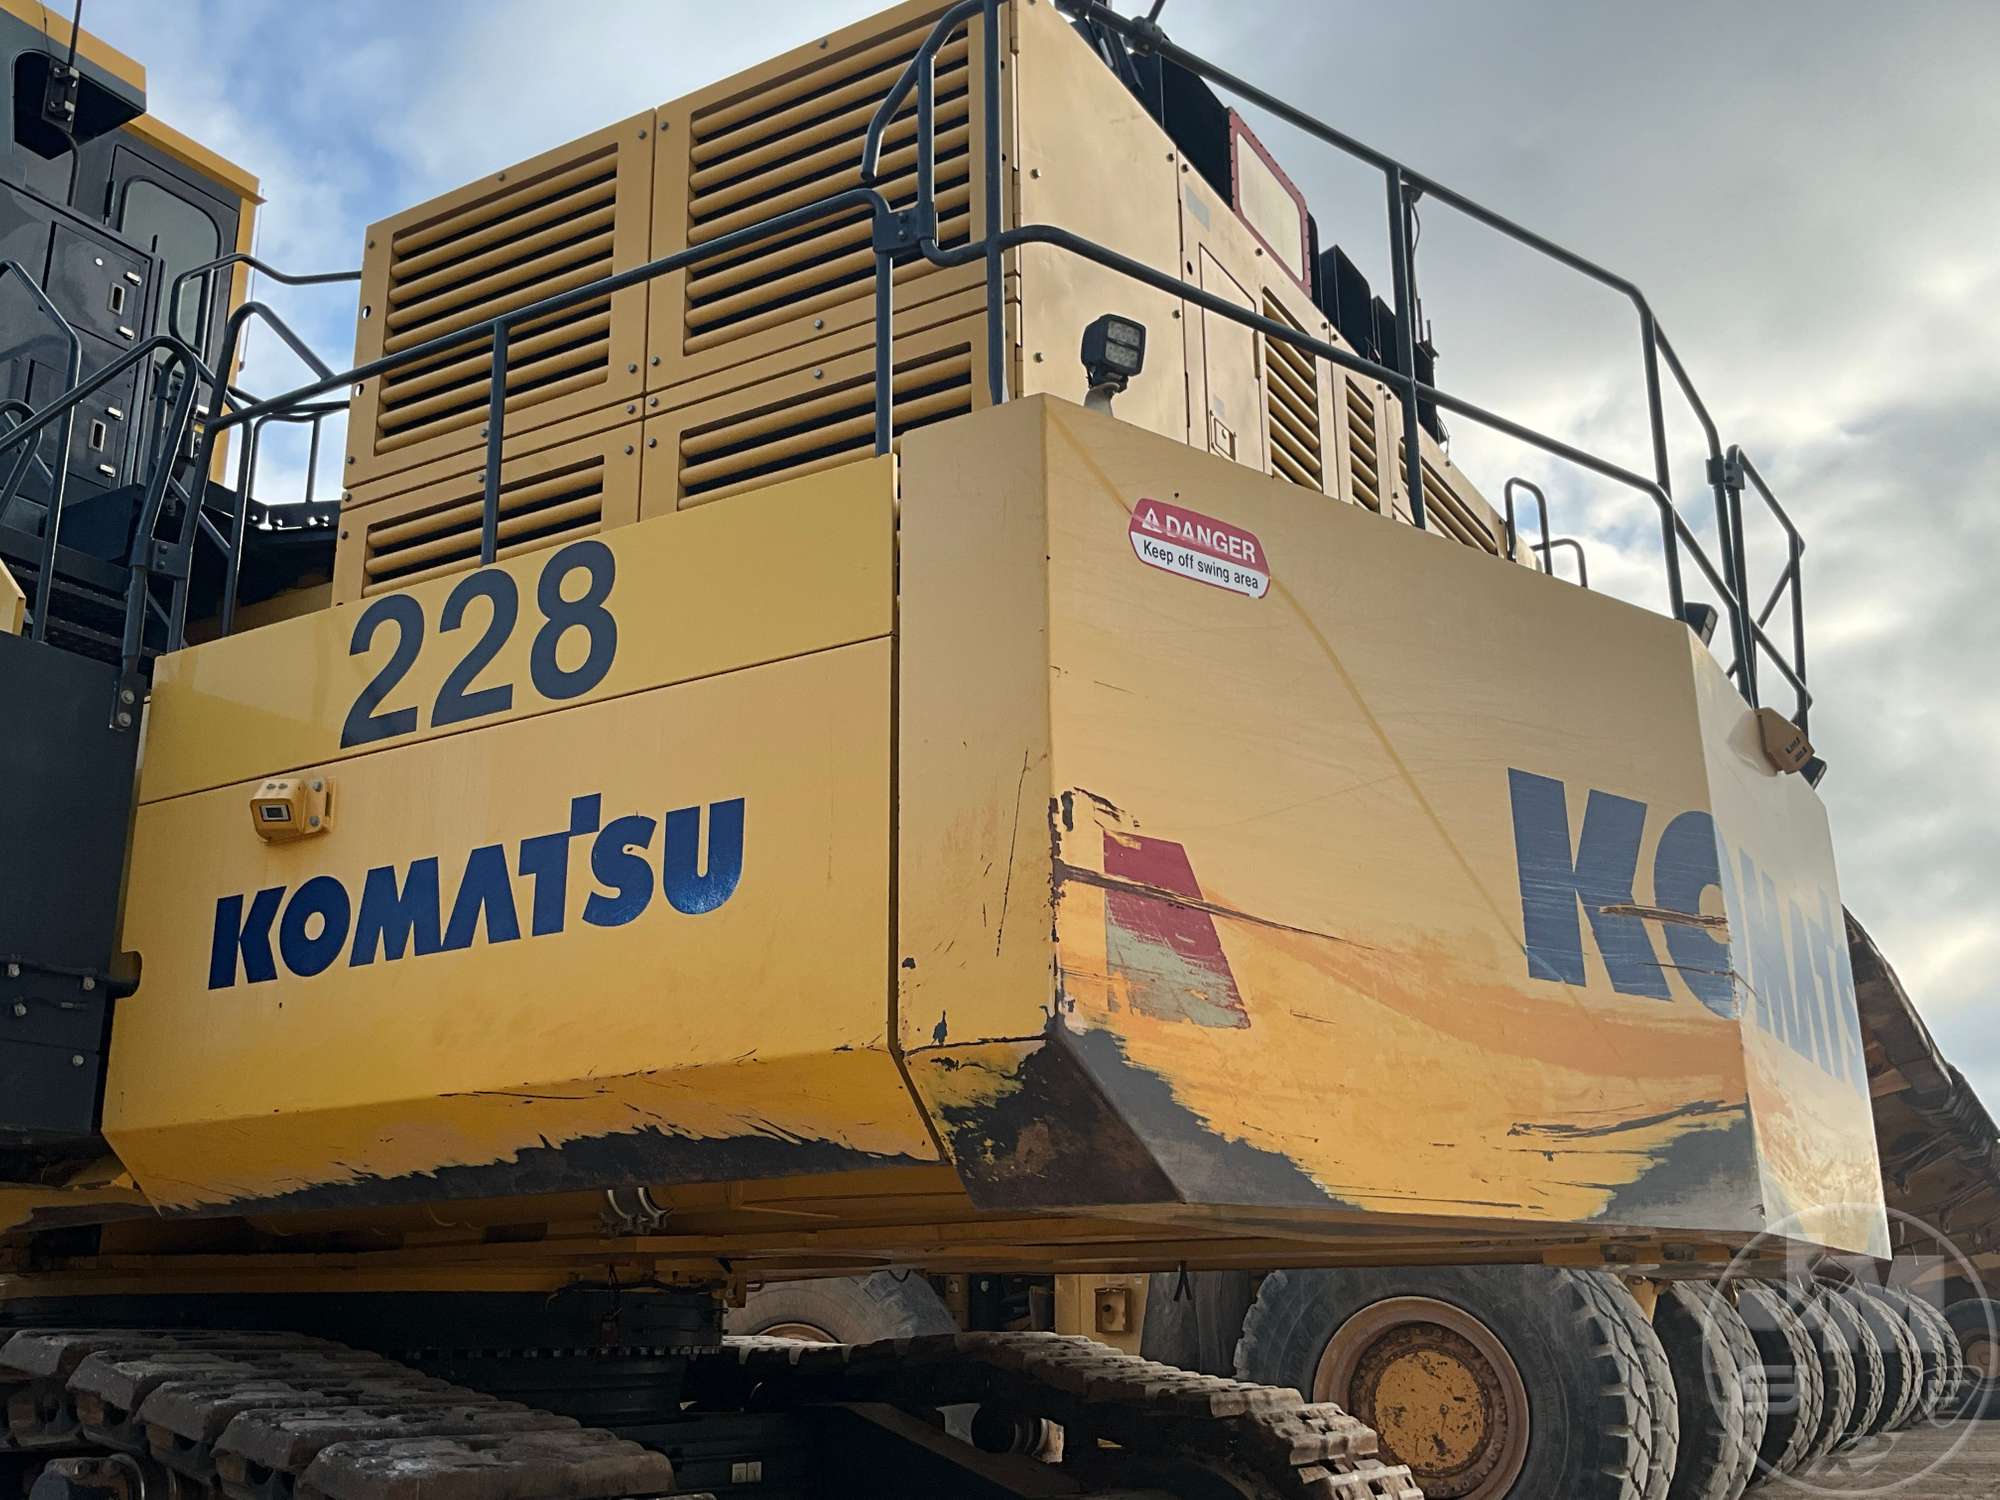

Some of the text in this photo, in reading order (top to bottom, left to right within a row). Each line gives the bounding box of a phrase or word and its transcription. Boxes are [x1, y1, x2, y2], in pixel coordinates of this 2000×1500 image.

[1143, 539, 1259, 589] Keep off swing area
[1165, 514, 1256, 564] DANGER
[340, 540, 618, 749] 228
[208, 793, 745, 990] KOMATSU
